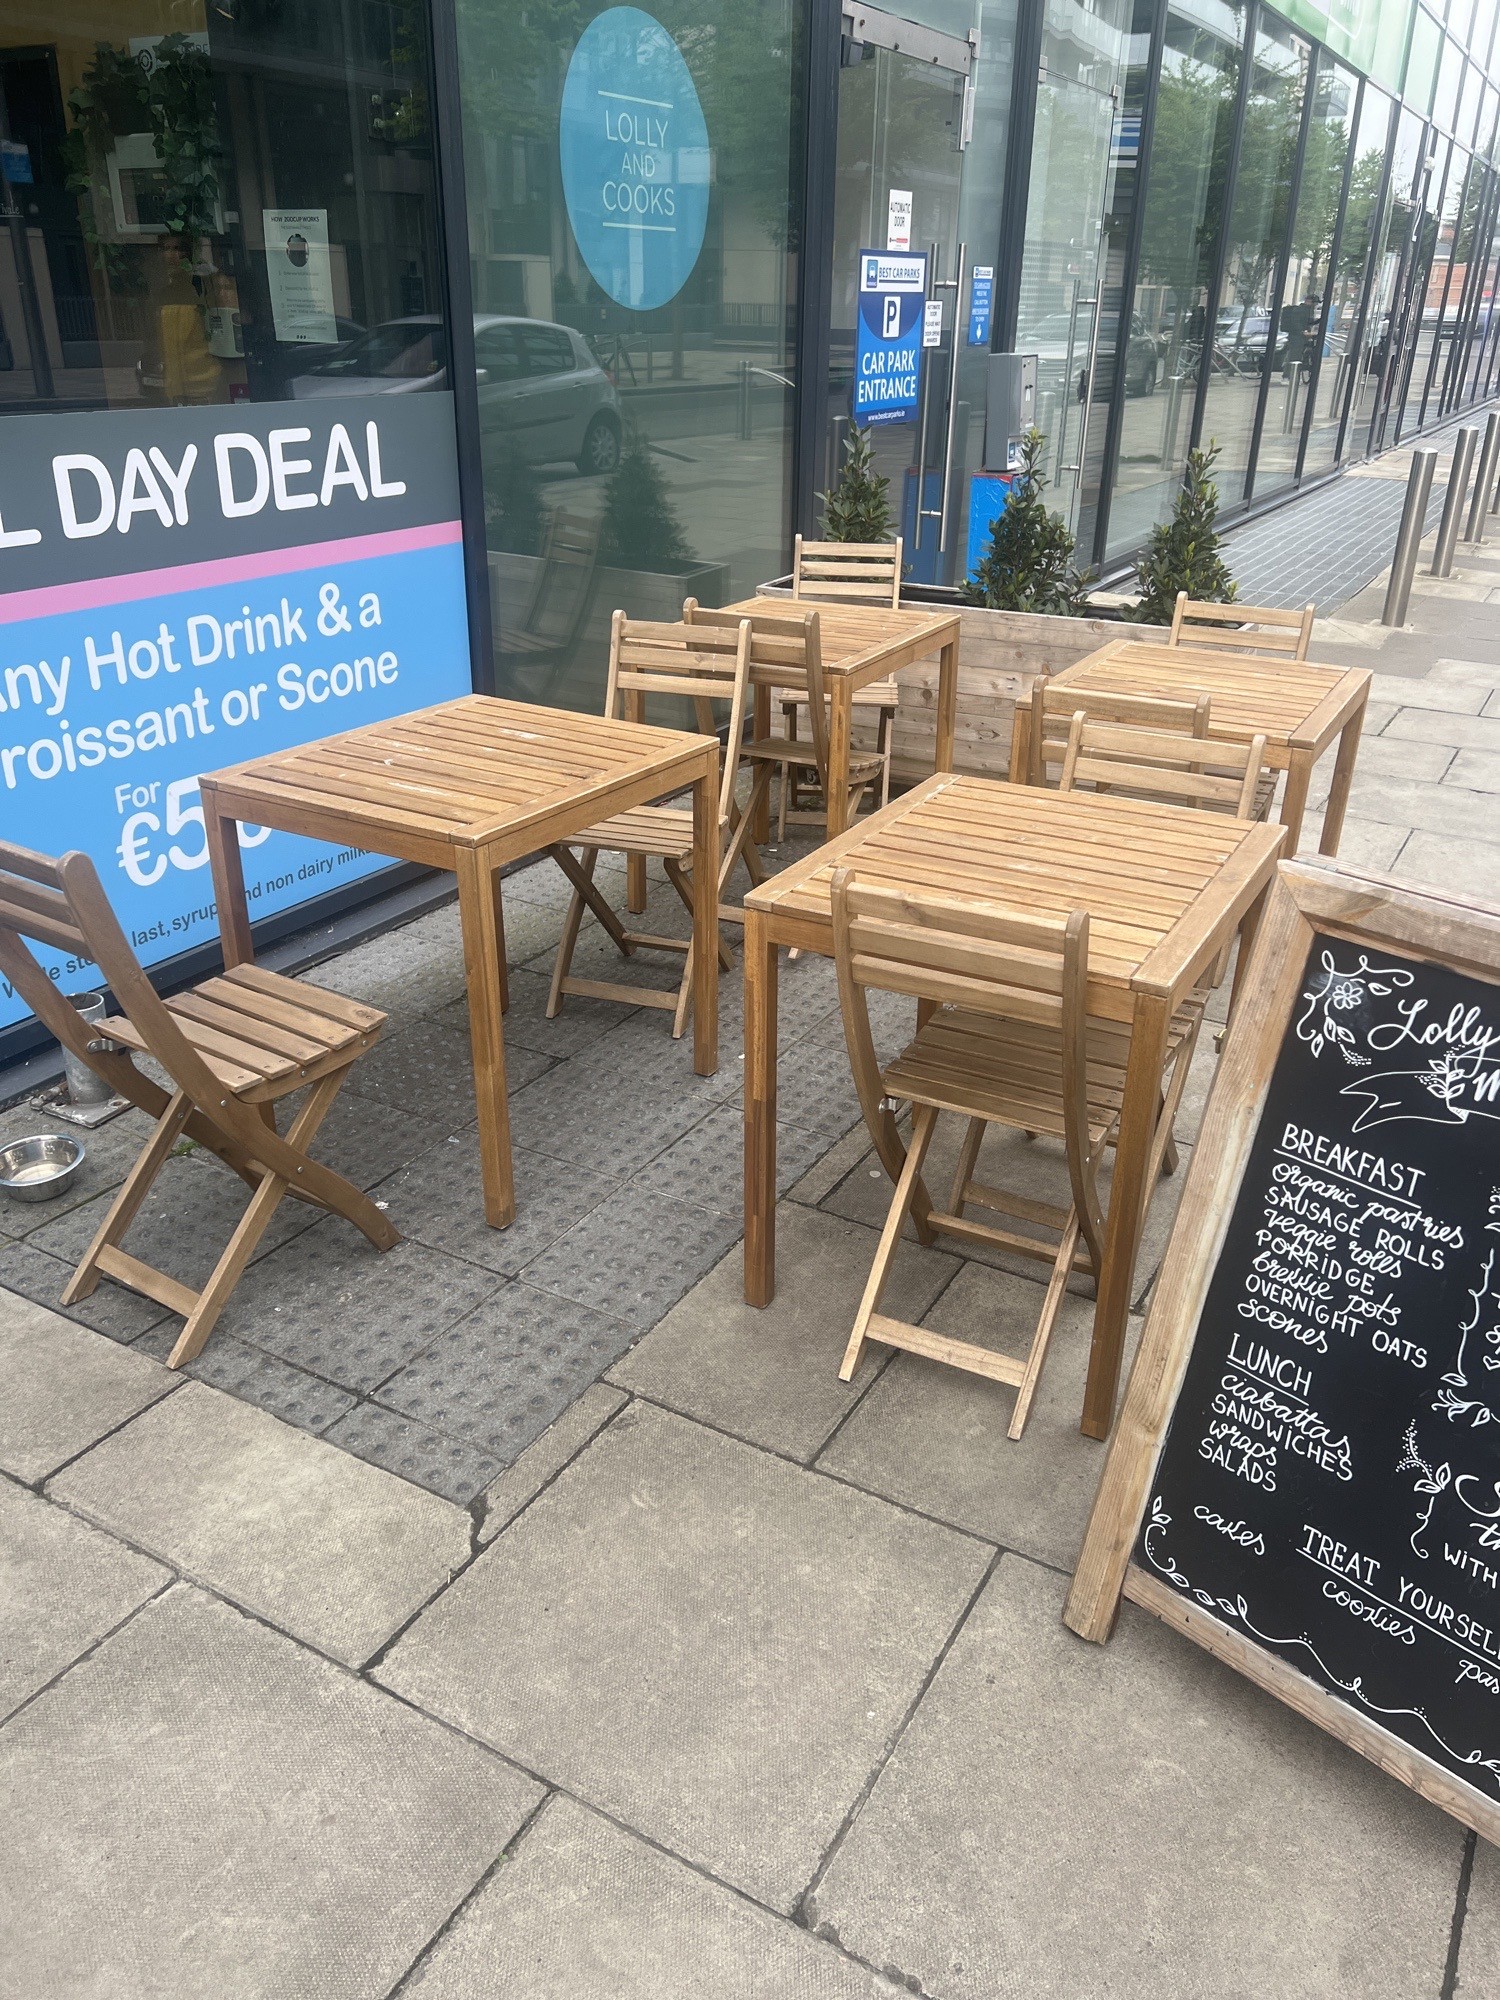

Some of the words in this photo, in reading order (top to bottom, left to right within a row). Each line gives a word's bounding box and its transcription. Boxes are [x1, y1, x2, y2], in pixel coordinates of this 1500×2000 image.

[605, 109, 669, 149] LOLLY
[621, 152, 656, 178] AND
[602, 180, 676, 217] COOKS
[894, 216, 906, 227] DOOR
[879, 267, 892, 278] BEST
[892, 267, 903, 279] CAR
[904, 268, 920, 279] PARKS
[886, 300, 897, 334] P
[858, 375, 917, 404] ENTRANCE
[862, 351, 886, 376] CAR
[887, 349, 916, 373] PARK
[52, 443, 199, 539] DAY
[213, 420, 406, 518] DEAL
[0, 655, 71, 716] ny
[84, 622, 182, 691] Hot
[187, 597, 307, 667] Drink
[316, 582, 352, 637] &
[358, 592, 382, 628] a
[220, 683, 268, 727] or
[277, 651, 399, 711] Scone
[114, 781, 161, 814] For
[266, 873, 294, 894] non
[298, 857, 334, 881] dairy
[337, 845, 371, 866] milk
[1367, 999, 1500, 1079] Lolly
[1280, 1122, 1426, 1197] BREAKFAST
[1264, 1186, 1363, 1238] SAUSAGE
[1375, 1228, 1445, 1271] ROLLS
[1272, 1162, 1360, 1209] organic
[1359, 1201, 1464, 1249] pastries
[1264, 1208, 1337, 1253] veggie
[1349, 1240, 1402, 1279] rolls
[1252, 1250, 1334, 1300] brekkie
[1338, 1292, 1402, 1326] pots
[1237, 1298, 1329, 1354] scones
[1372, 1330, 1428, 1369] OATS
[1227, 1332, 1313, 1397] LUNCH
[1209, 1419, 1277, 1467] wraps
[1221, 1374, 1351, 1461] ciabattas
[1198, 1437, 1277, 1492] SALADS
[1193, 1505, 1266, 1556] cakes
[1302, 1524, 1381, 1587] TREAT
[1397, 1576, 1500, 1660] YOURSEL
[1321, 1579, 1417, 1646] cookies
